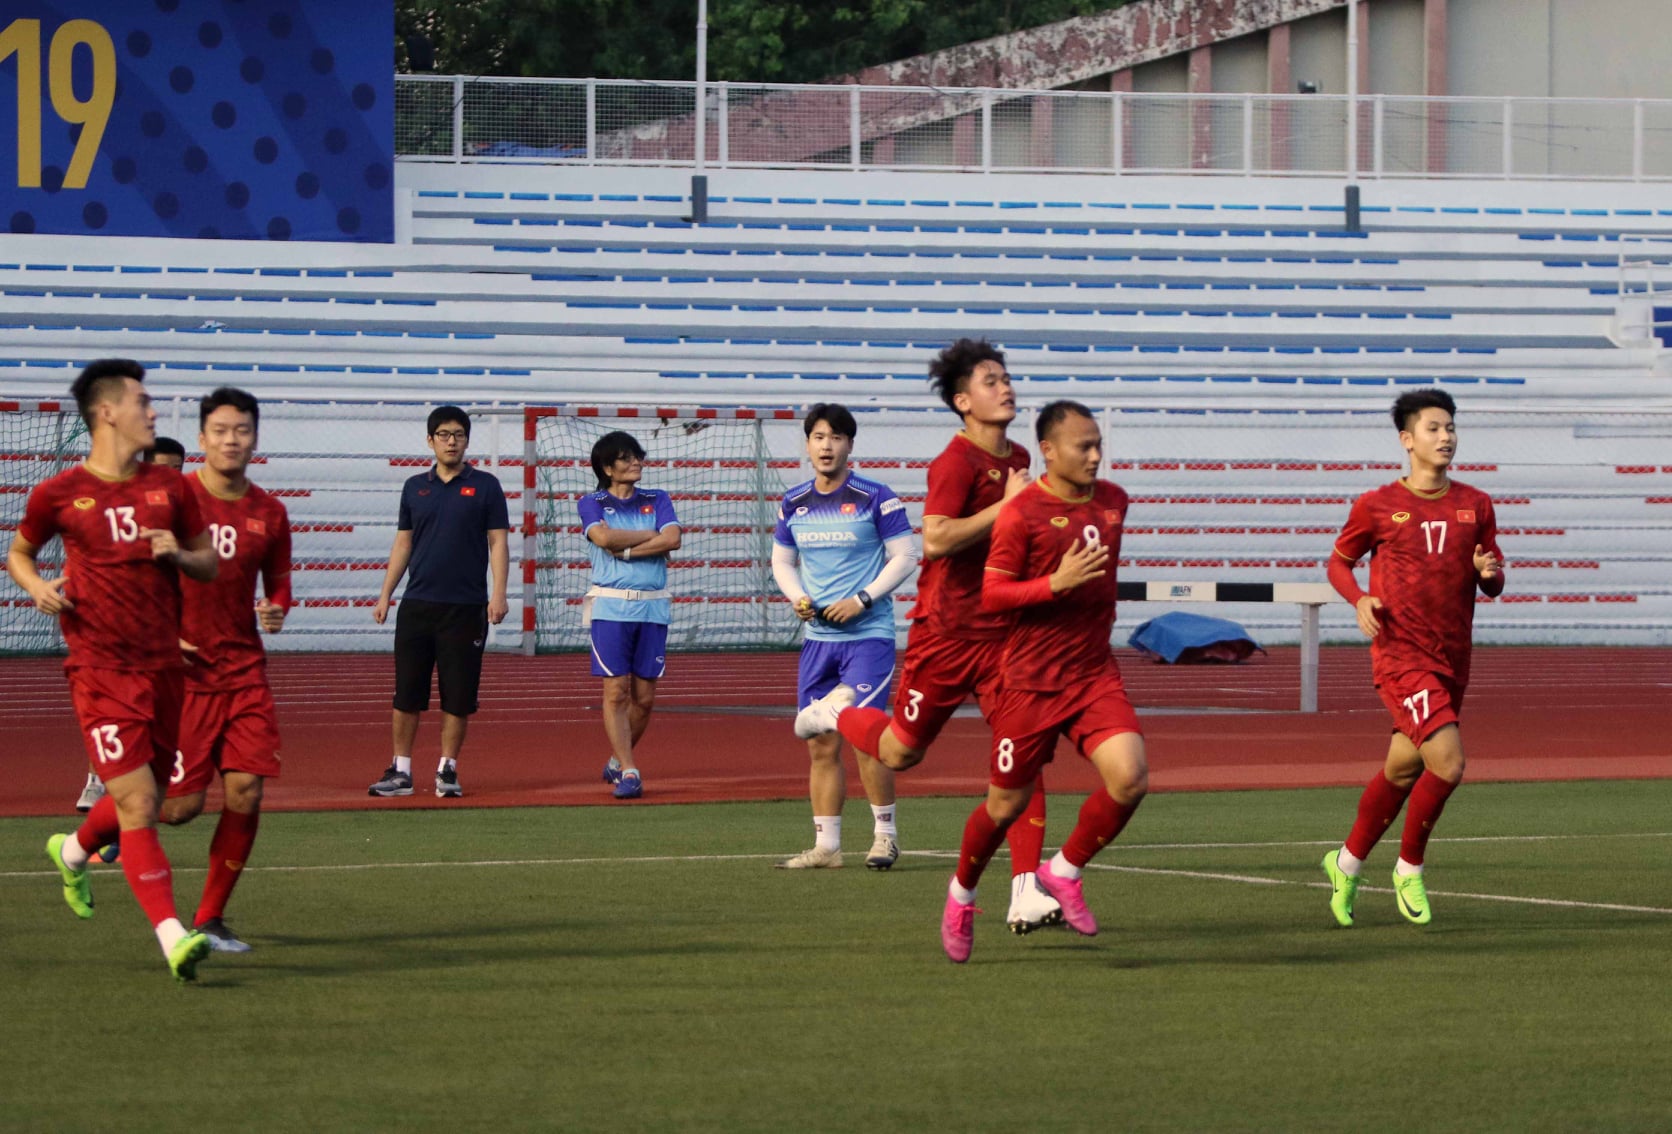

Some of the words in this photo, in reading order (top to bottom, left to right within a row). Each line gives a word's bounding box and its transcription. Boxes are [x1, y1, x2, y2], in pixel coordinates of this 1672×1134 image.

[0, 18, 117, 189] 19
[104, 506, 138, 543] 13
[209, 523, 237, 559] 18
[796, 531, 858, 543] HONDA
[1420, 520, 1447, 554] 17
[904, 688, 924, 722] 3
[1403, 688, 1429, 725] 17
[91, 724, 124, 764] 13
[997, 737, 1014, 773] 8
